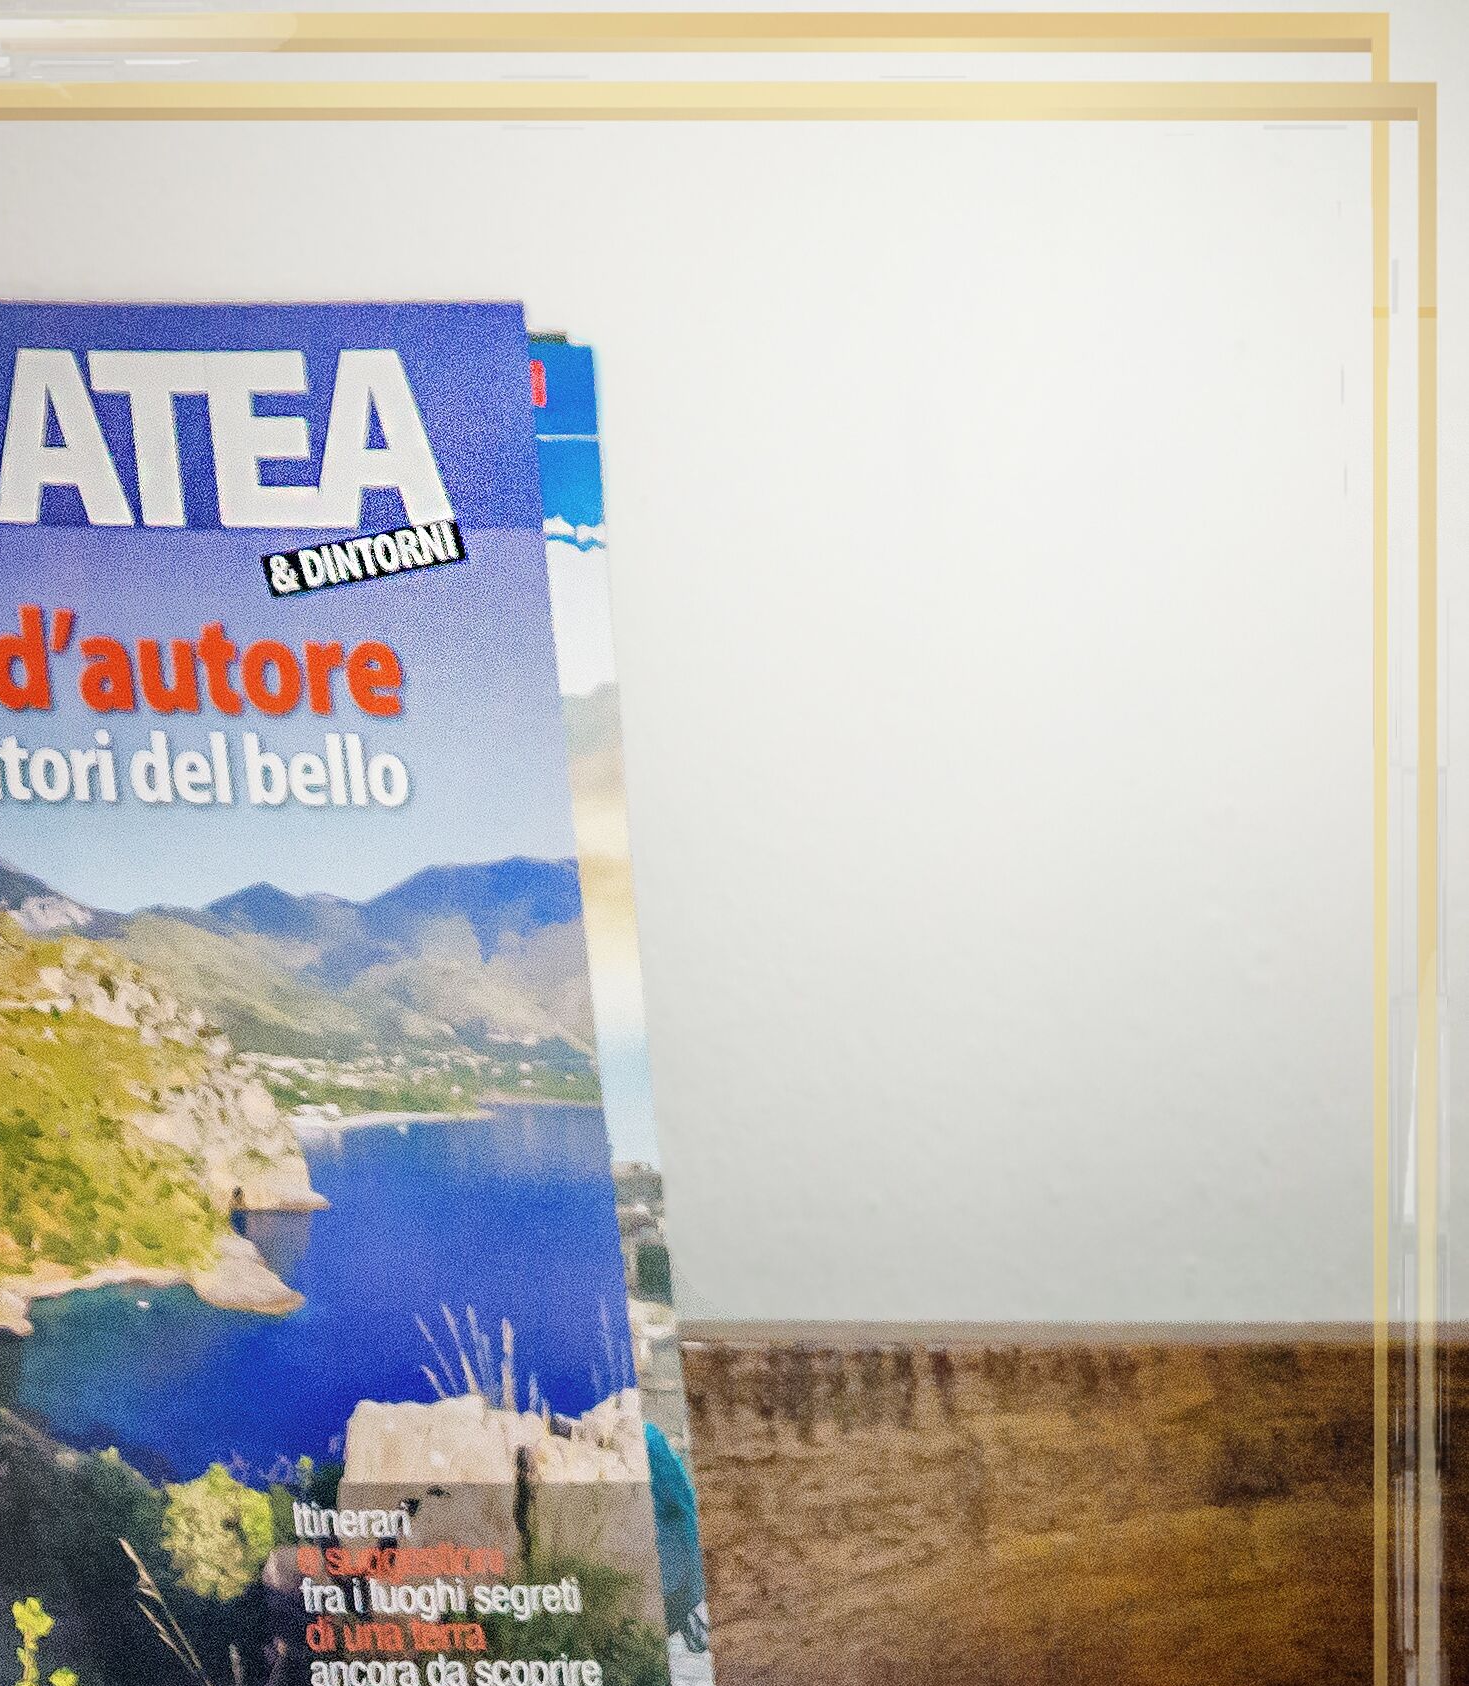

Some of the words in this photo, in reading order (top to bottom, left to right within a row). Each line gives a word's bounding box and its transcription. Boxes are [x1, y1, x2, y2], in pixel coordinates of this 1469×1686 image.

[269, 555, 301, 594] &
[298, 520, 460, 589] DINTORNI
[130, 730, 232, 805] del
[243, 731, 410, 808] bello
[292, 1500, 413, 1540] Itinerari
[368, 1577, 467, 1622] luoghi
[472, 1576, 584, 1622] segreti
[305, 1614, 336, 1652] di
[343, 1621, 405, 1652] una
[411, 1618, 489, 1652] terra
